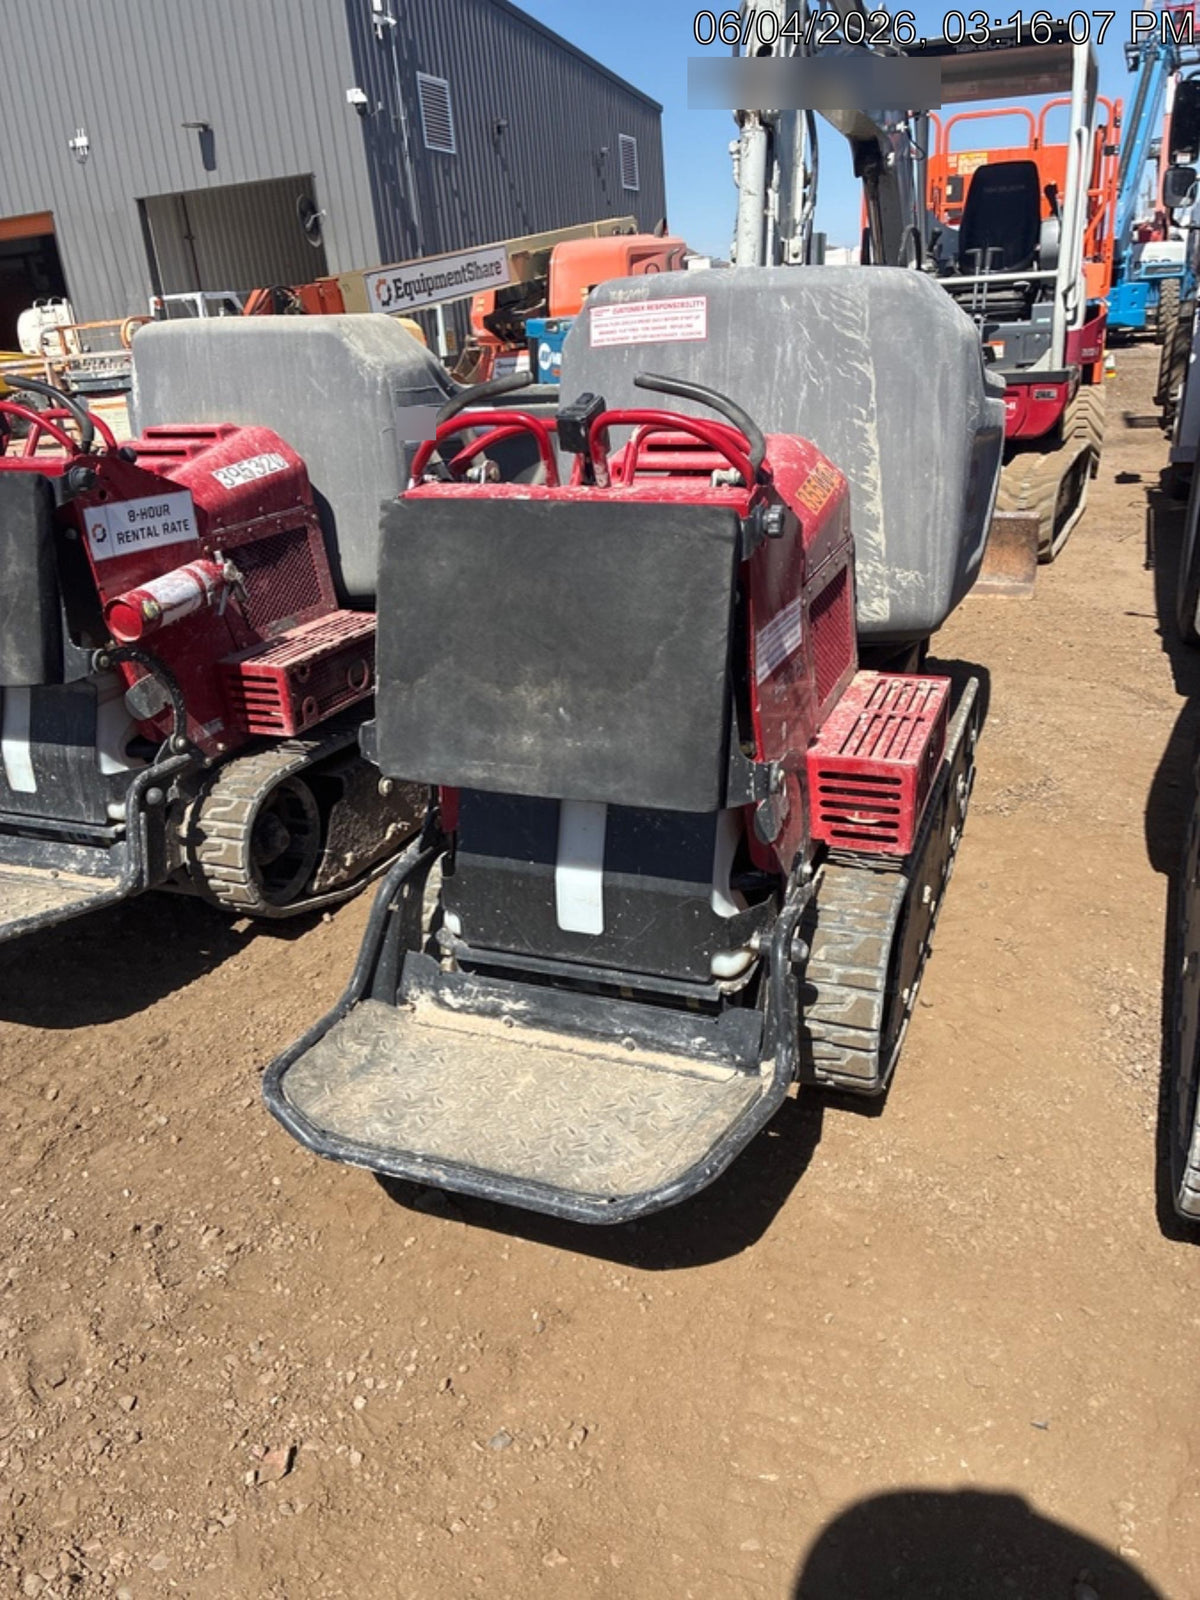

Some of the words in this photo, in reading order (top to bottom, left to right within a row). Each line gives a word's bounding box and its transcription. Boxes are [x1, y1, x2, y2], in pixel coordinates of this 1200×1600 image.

[391, 259, 502, 301] EquipmentShare
[127, 503, 171, 523] 8-HOUR
[116, 525, 160, 545] RENTAL
[161, 518, 190, 536] RATE
